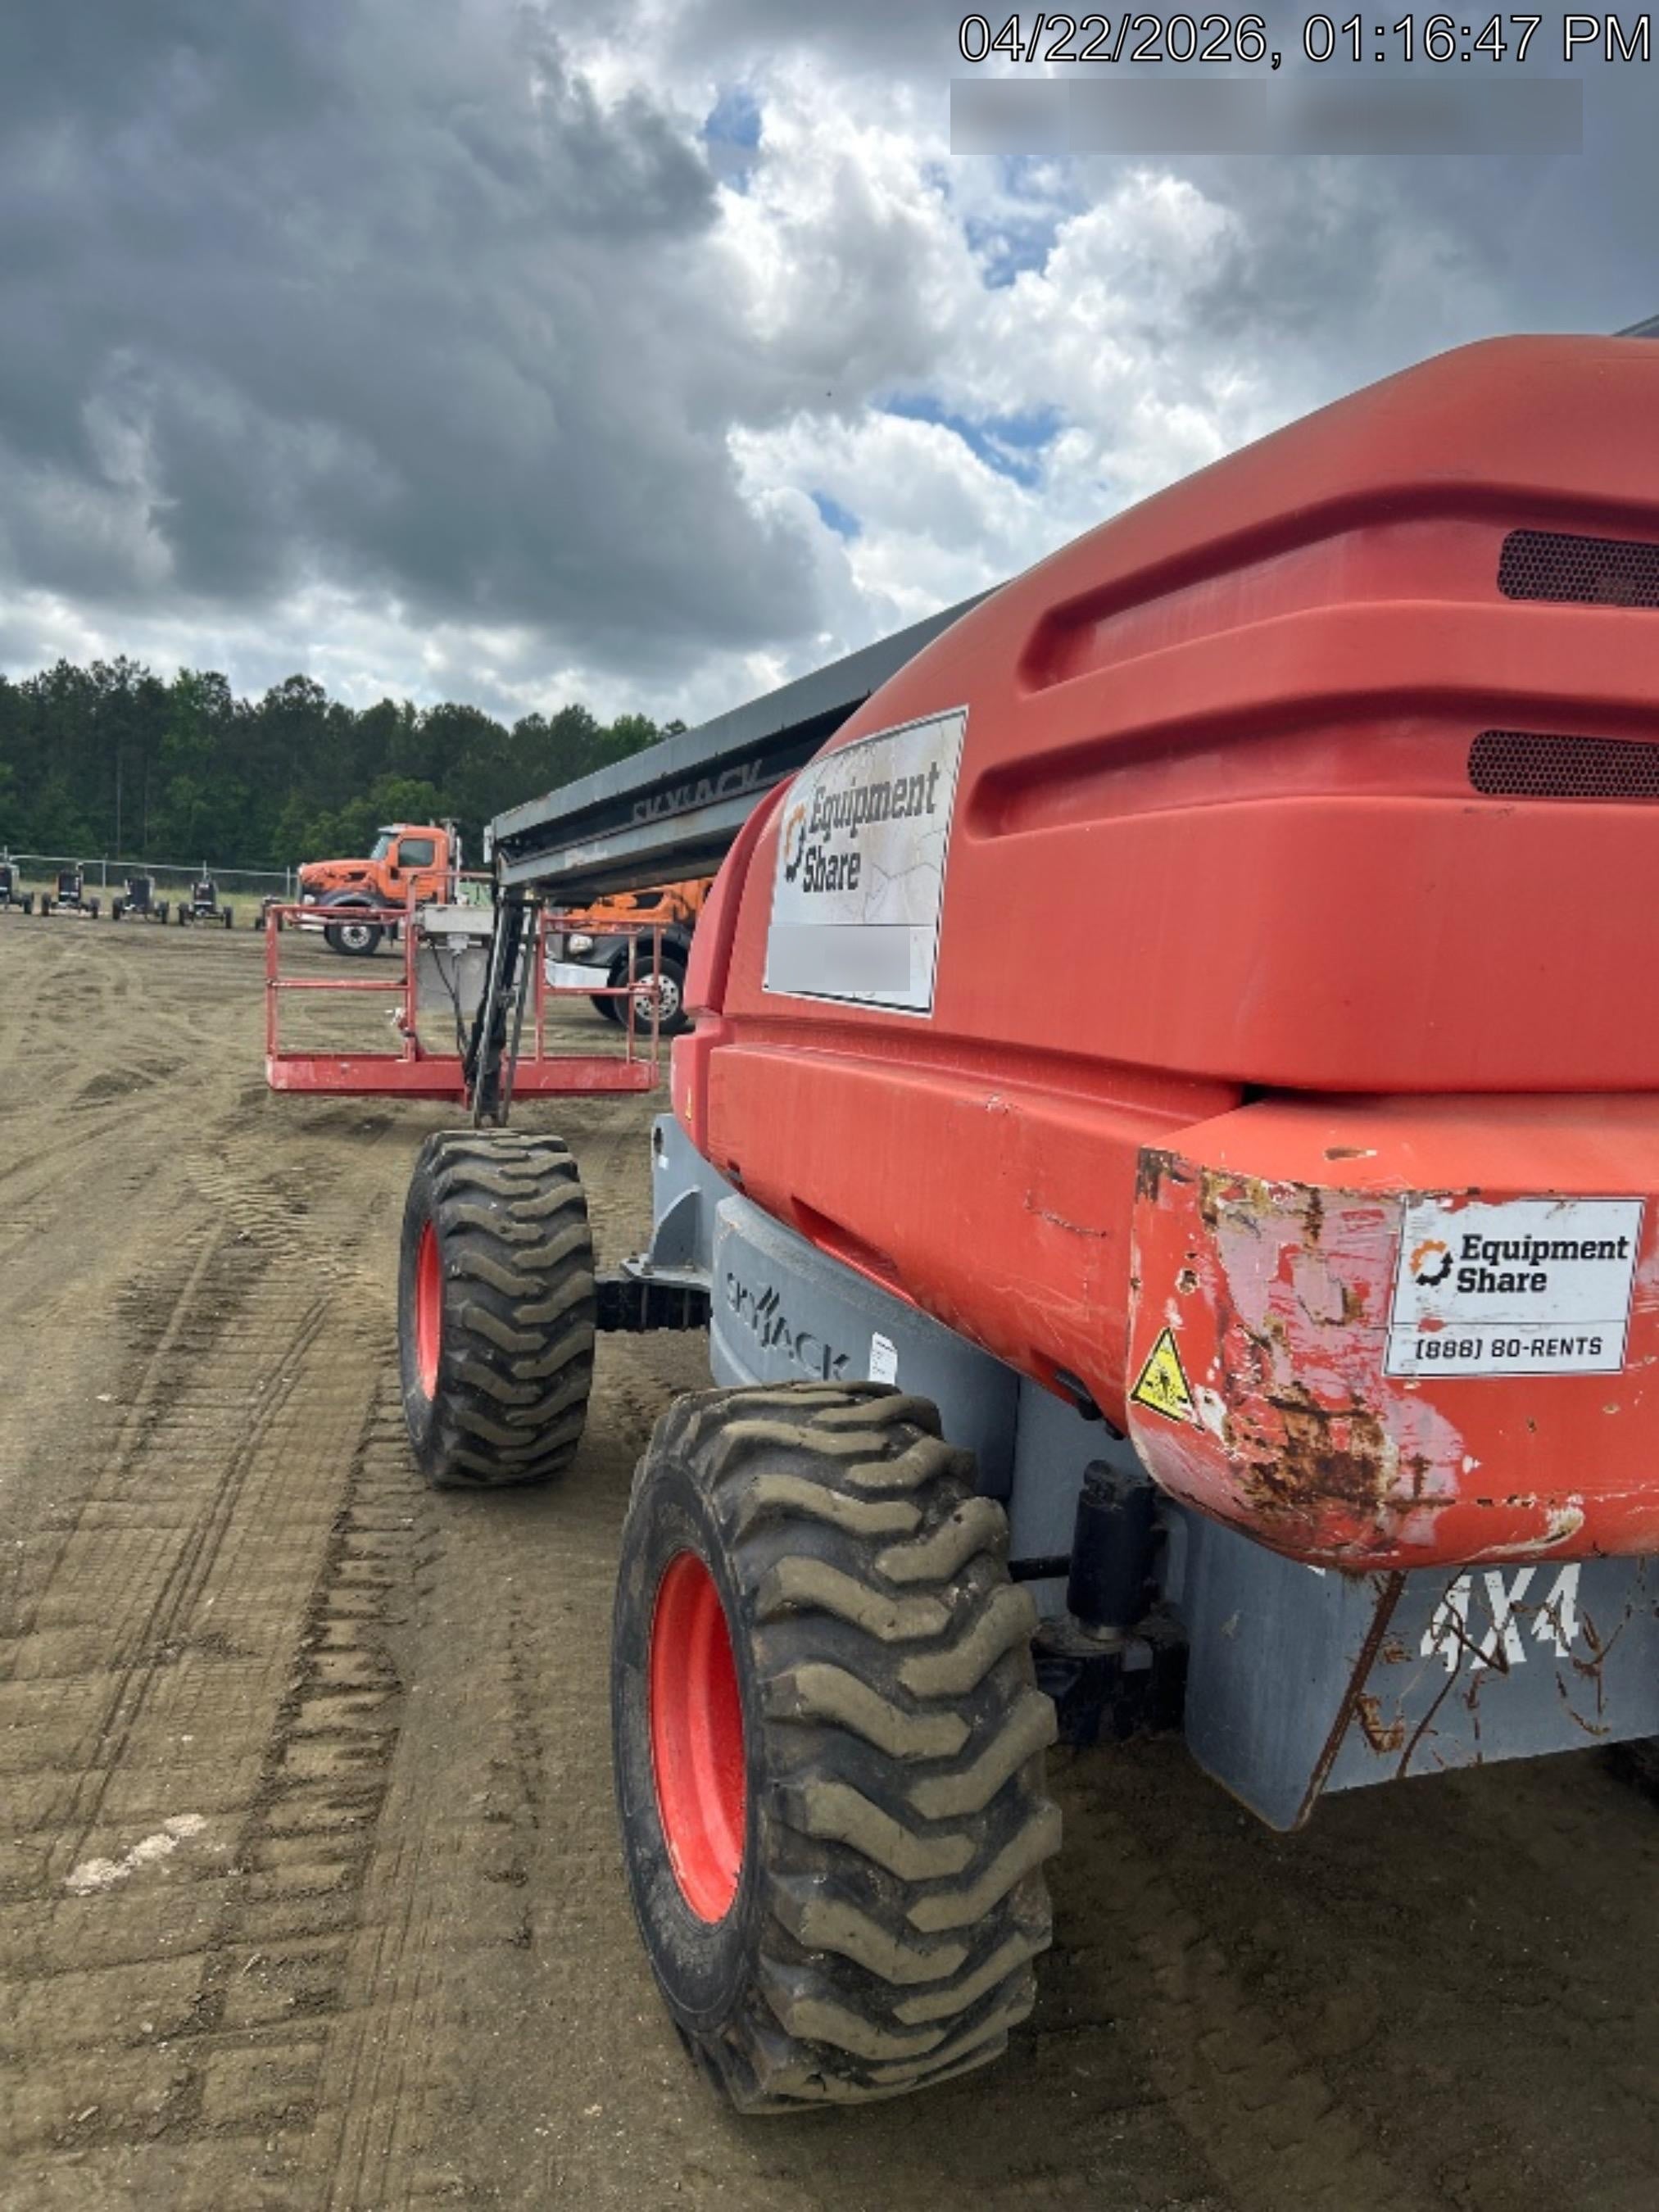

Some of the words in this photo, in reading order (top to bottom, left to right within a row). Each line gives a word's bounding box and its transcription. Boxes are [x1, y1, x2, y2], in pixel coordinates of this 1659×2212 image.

[808, 761, 940, 843] Equipment
[803, 845, 861, 893] Share
[1459, 1234, 1630, 1266] Equipment
[1457, 1267, 1547, 1294] Share
[727, 1271, 851, 1382] SKYJACK
[1415, 1339, 1483, 1360] (888)
[1491, 1337, 1603, 1358] 80-RENTS
[1420, 1562, 1582, 1673] 4X4
